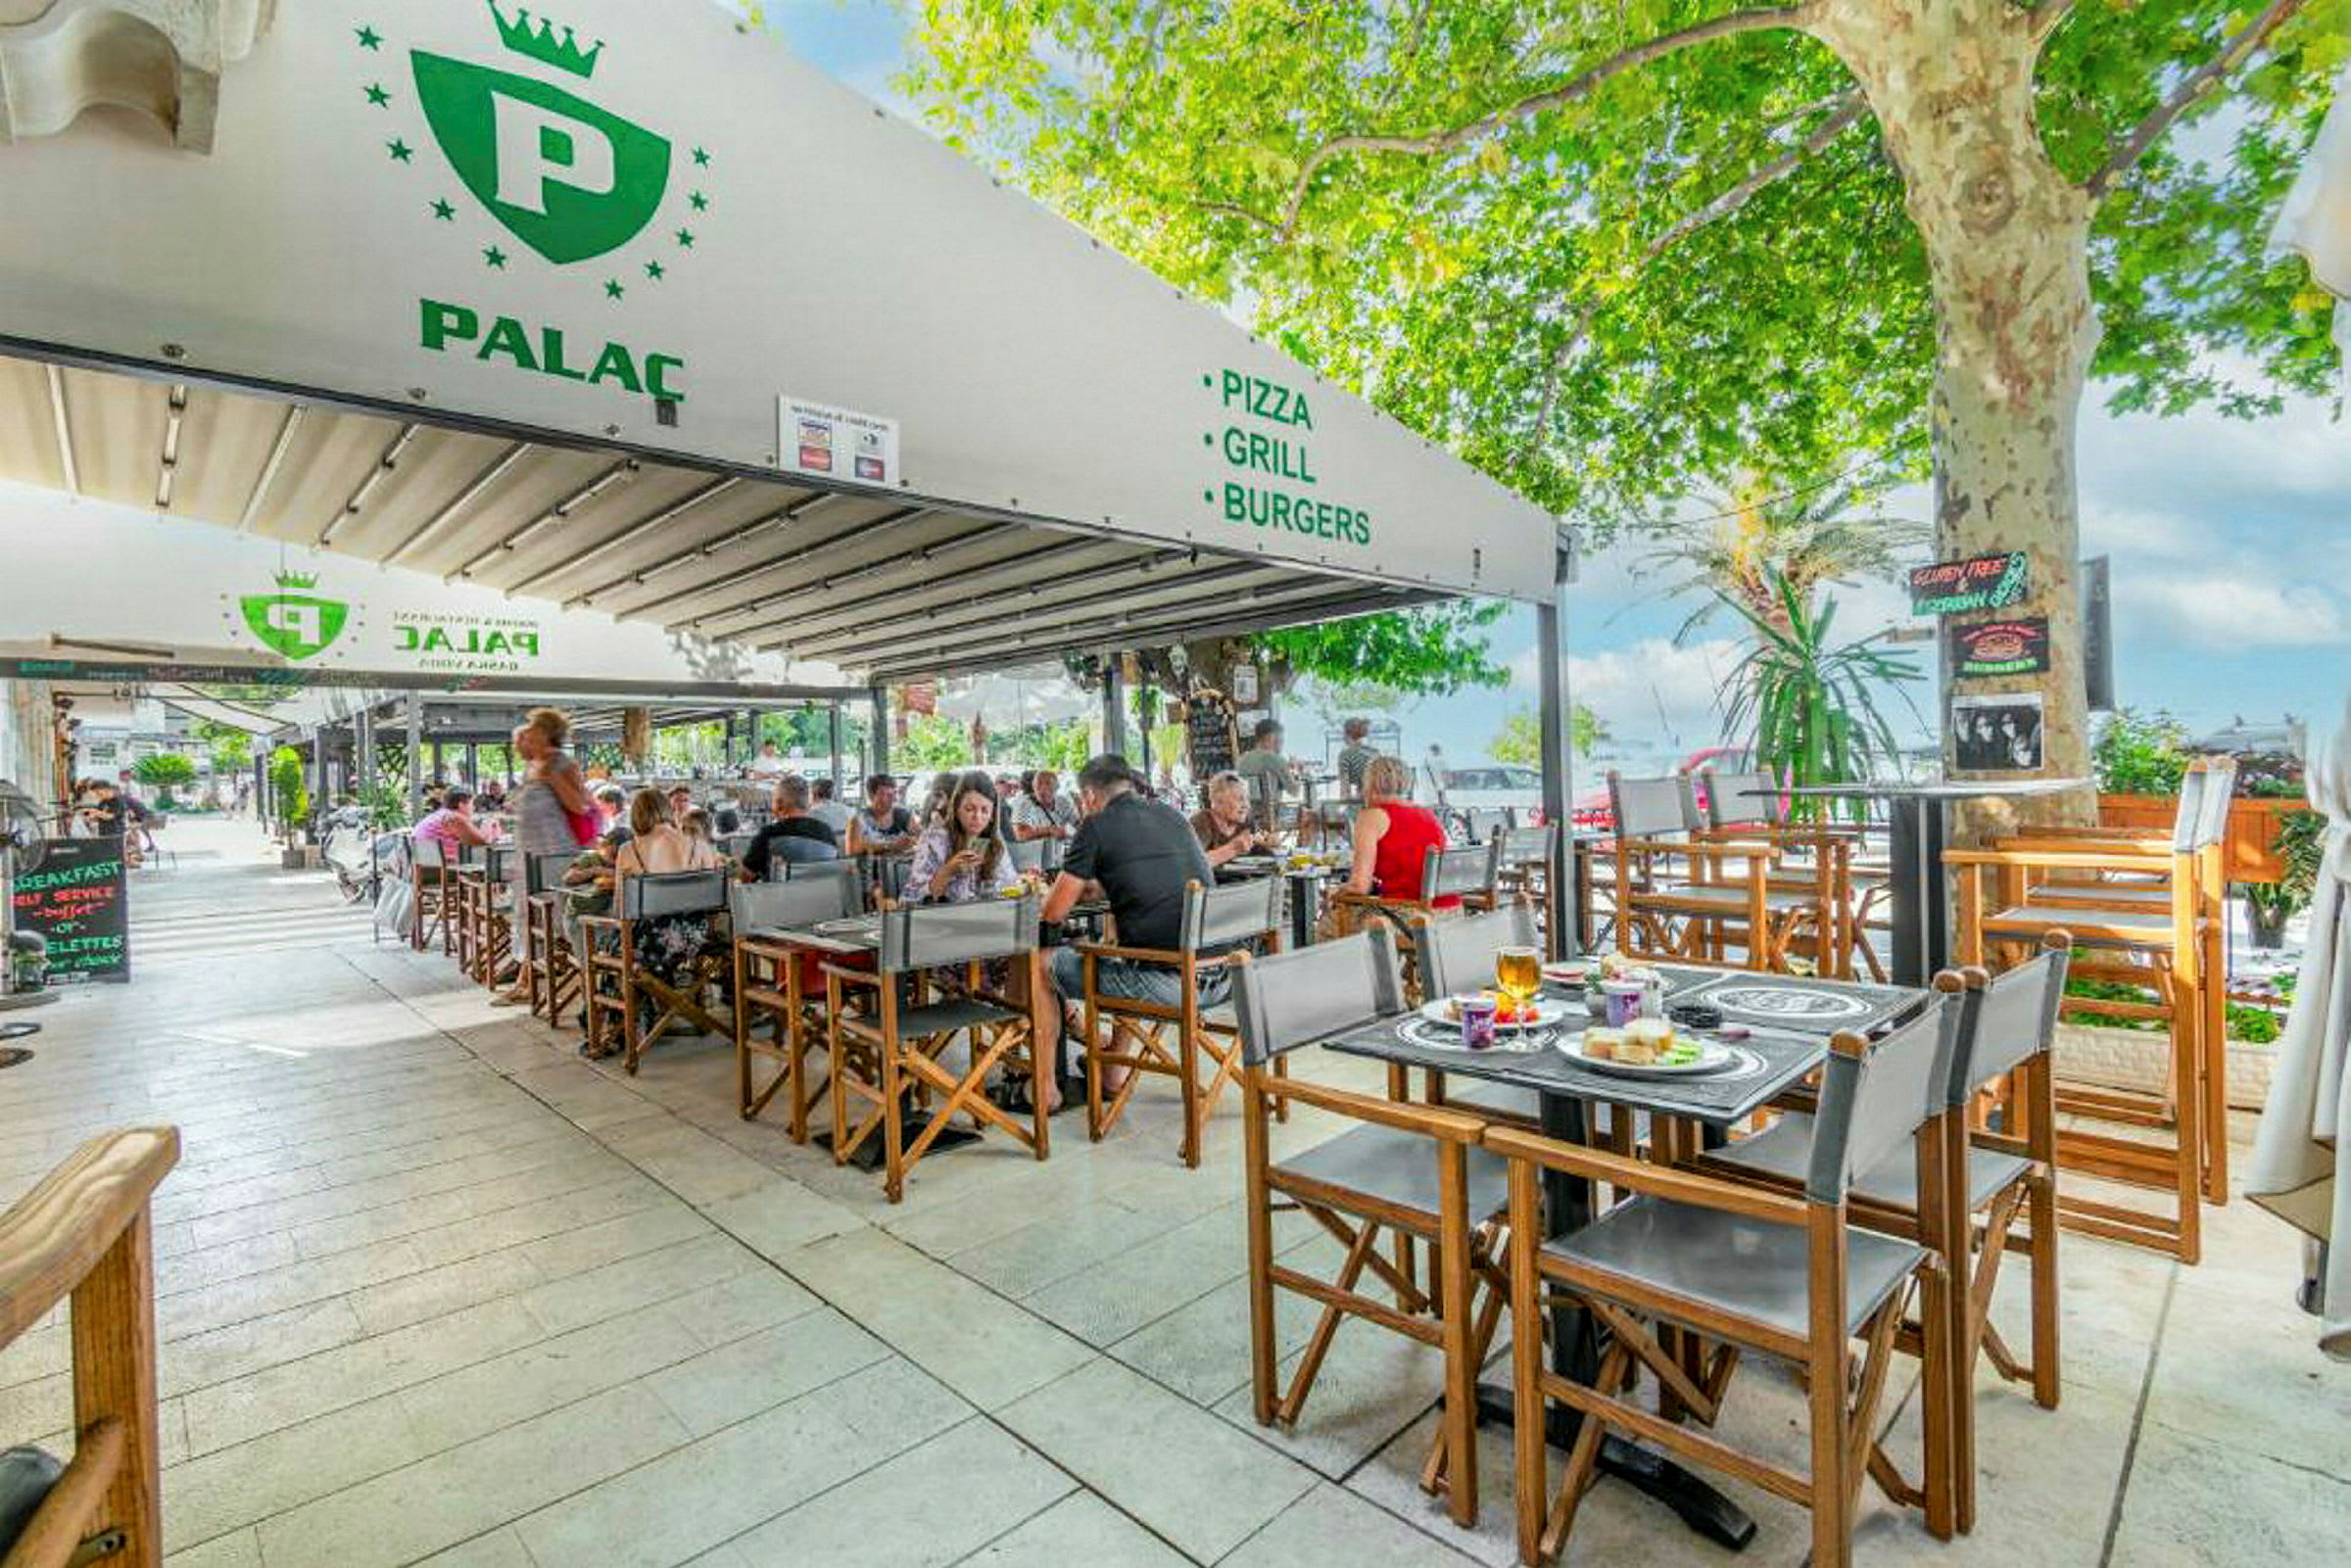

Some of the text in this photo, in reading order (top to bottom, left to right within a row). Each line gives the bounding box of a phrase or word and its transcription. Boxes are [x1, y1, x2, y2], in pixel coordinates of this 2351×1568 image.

[419, 298, 685, 403] PALAC
[1223, 368, 1313, 431] PIZZA
[1224, 426, 1318, 484] GRILL
[1224, 482, 1371, 546] BURGERS
[54, 885, 115, 903] SERVICE
[47, 934, 124, 955] ELETTES
